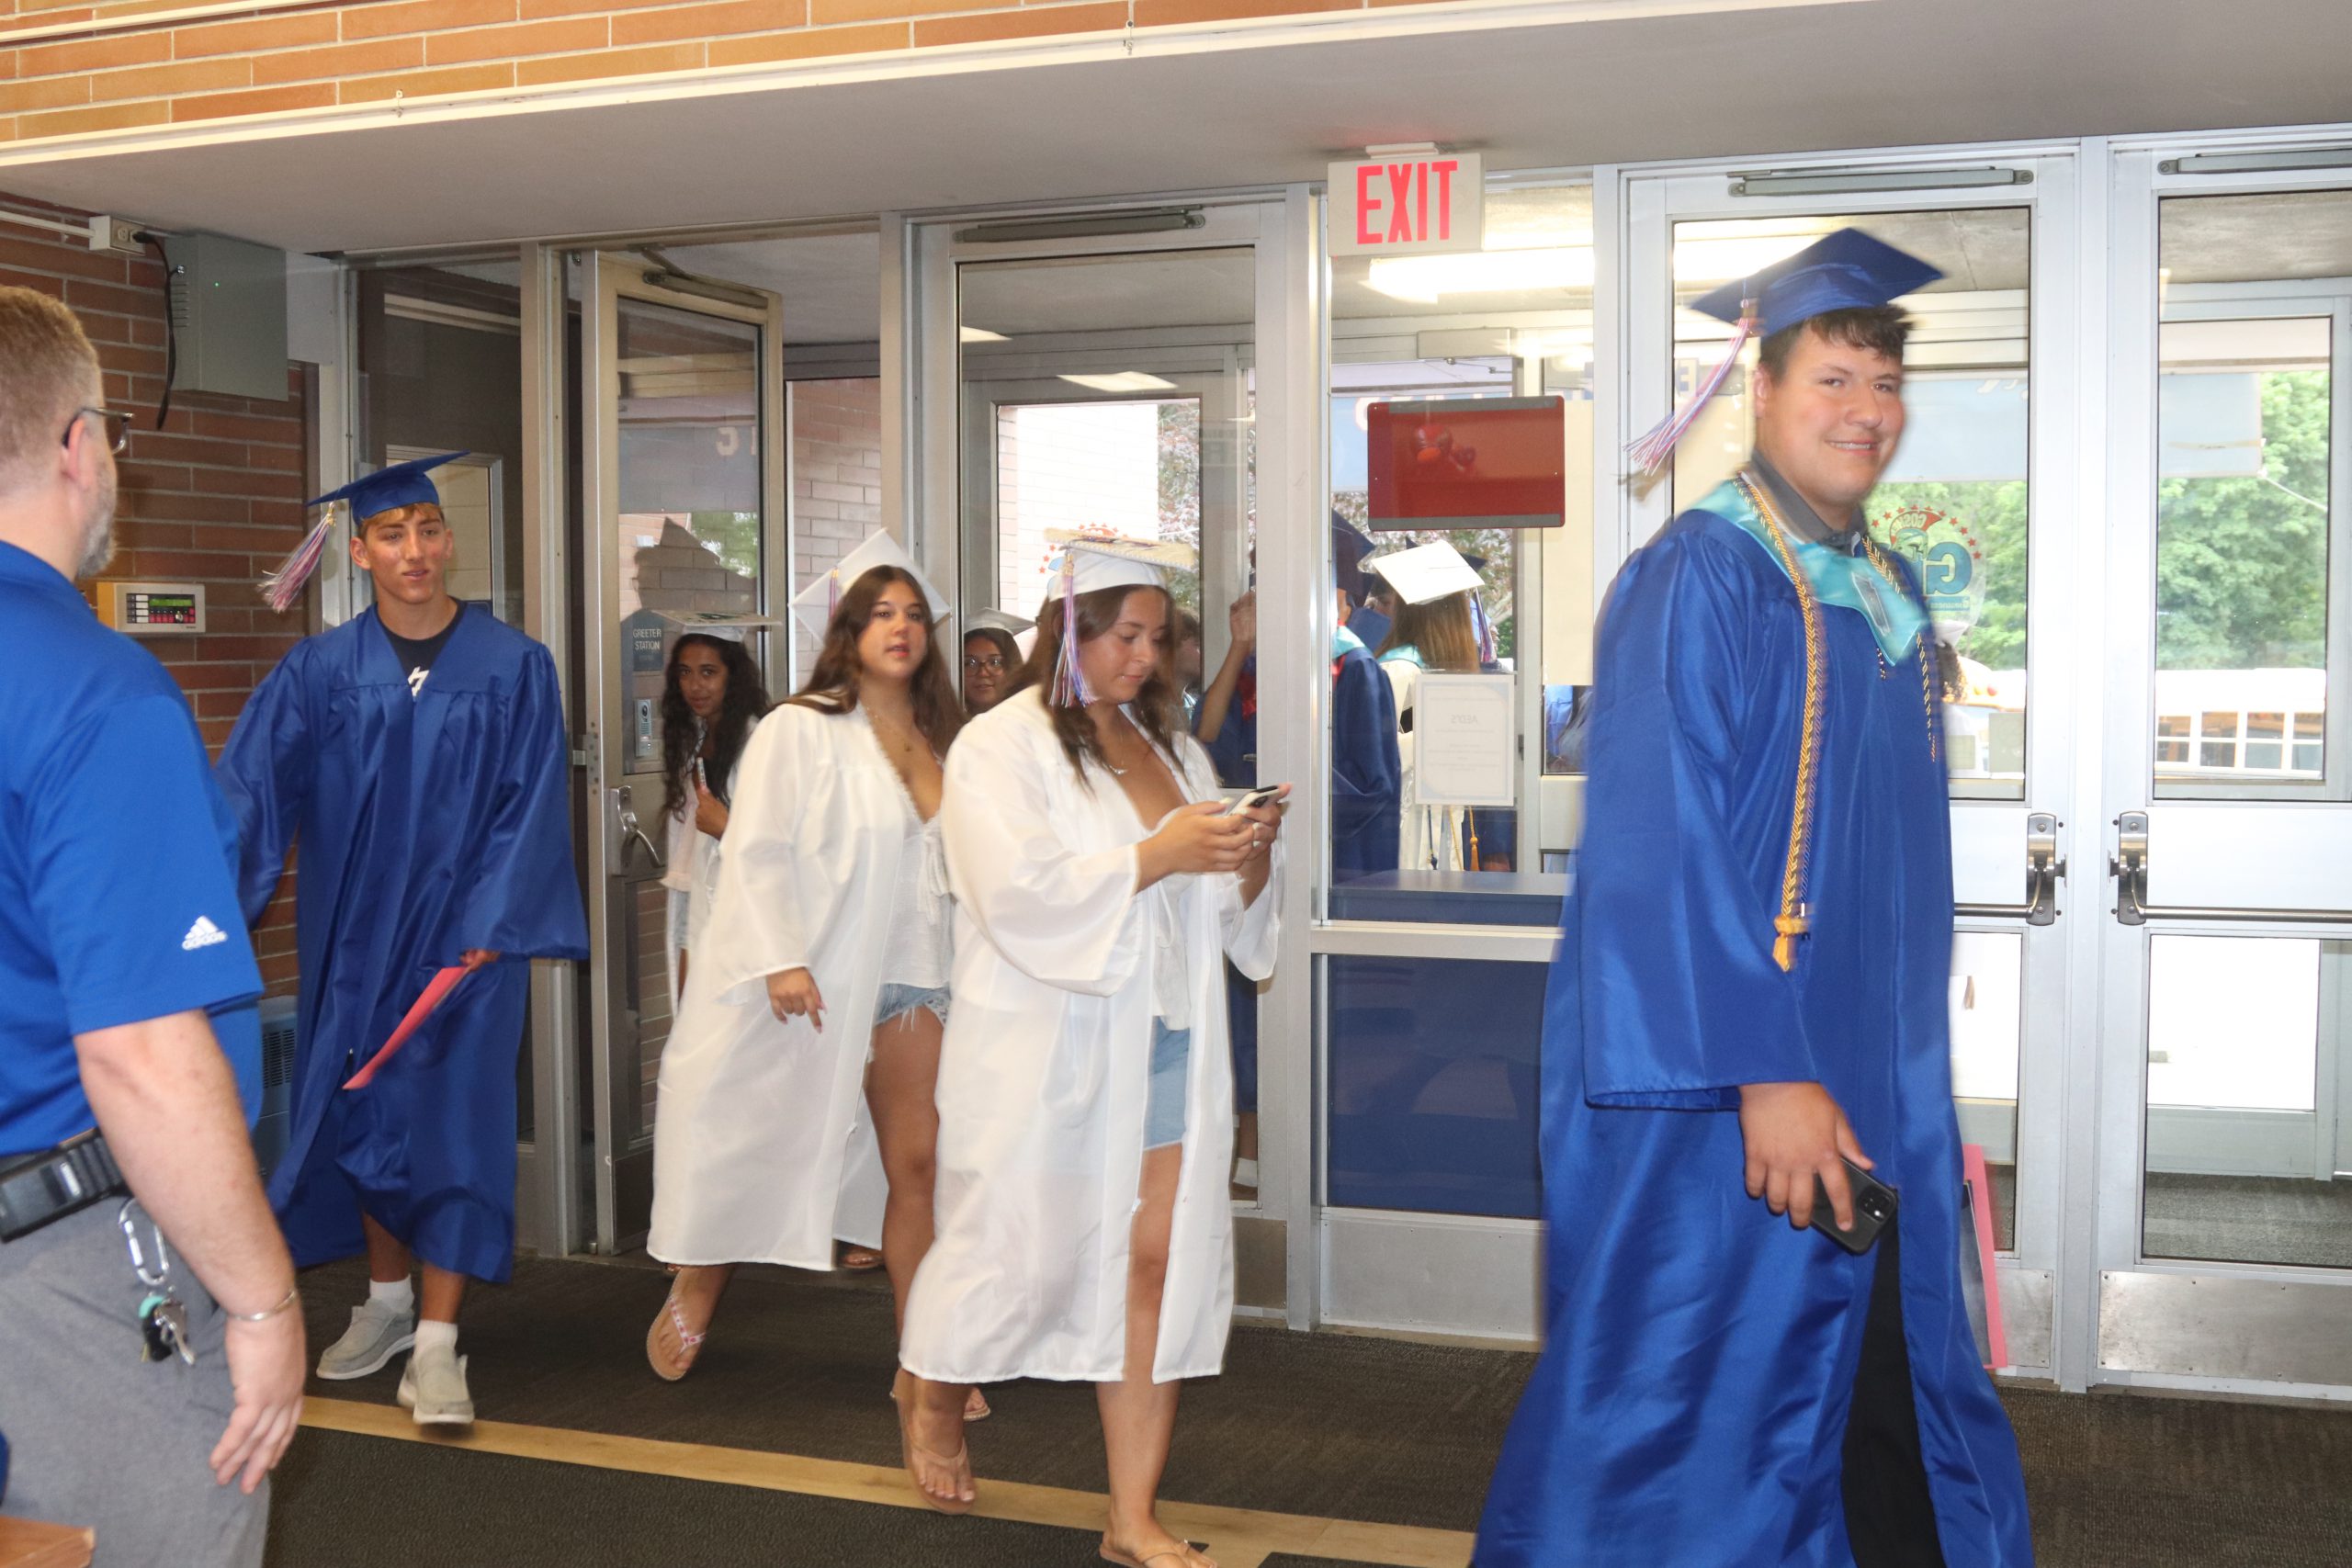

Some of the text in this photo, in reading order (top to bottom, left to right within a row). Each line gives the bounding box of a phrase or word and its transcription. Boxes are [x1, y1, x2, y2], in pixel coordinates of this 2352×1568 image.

[1357, 160, 1458, 244] EXIT
[632, 628, 662, 638] GREETER
[634, 640, 661, 650] STATION
